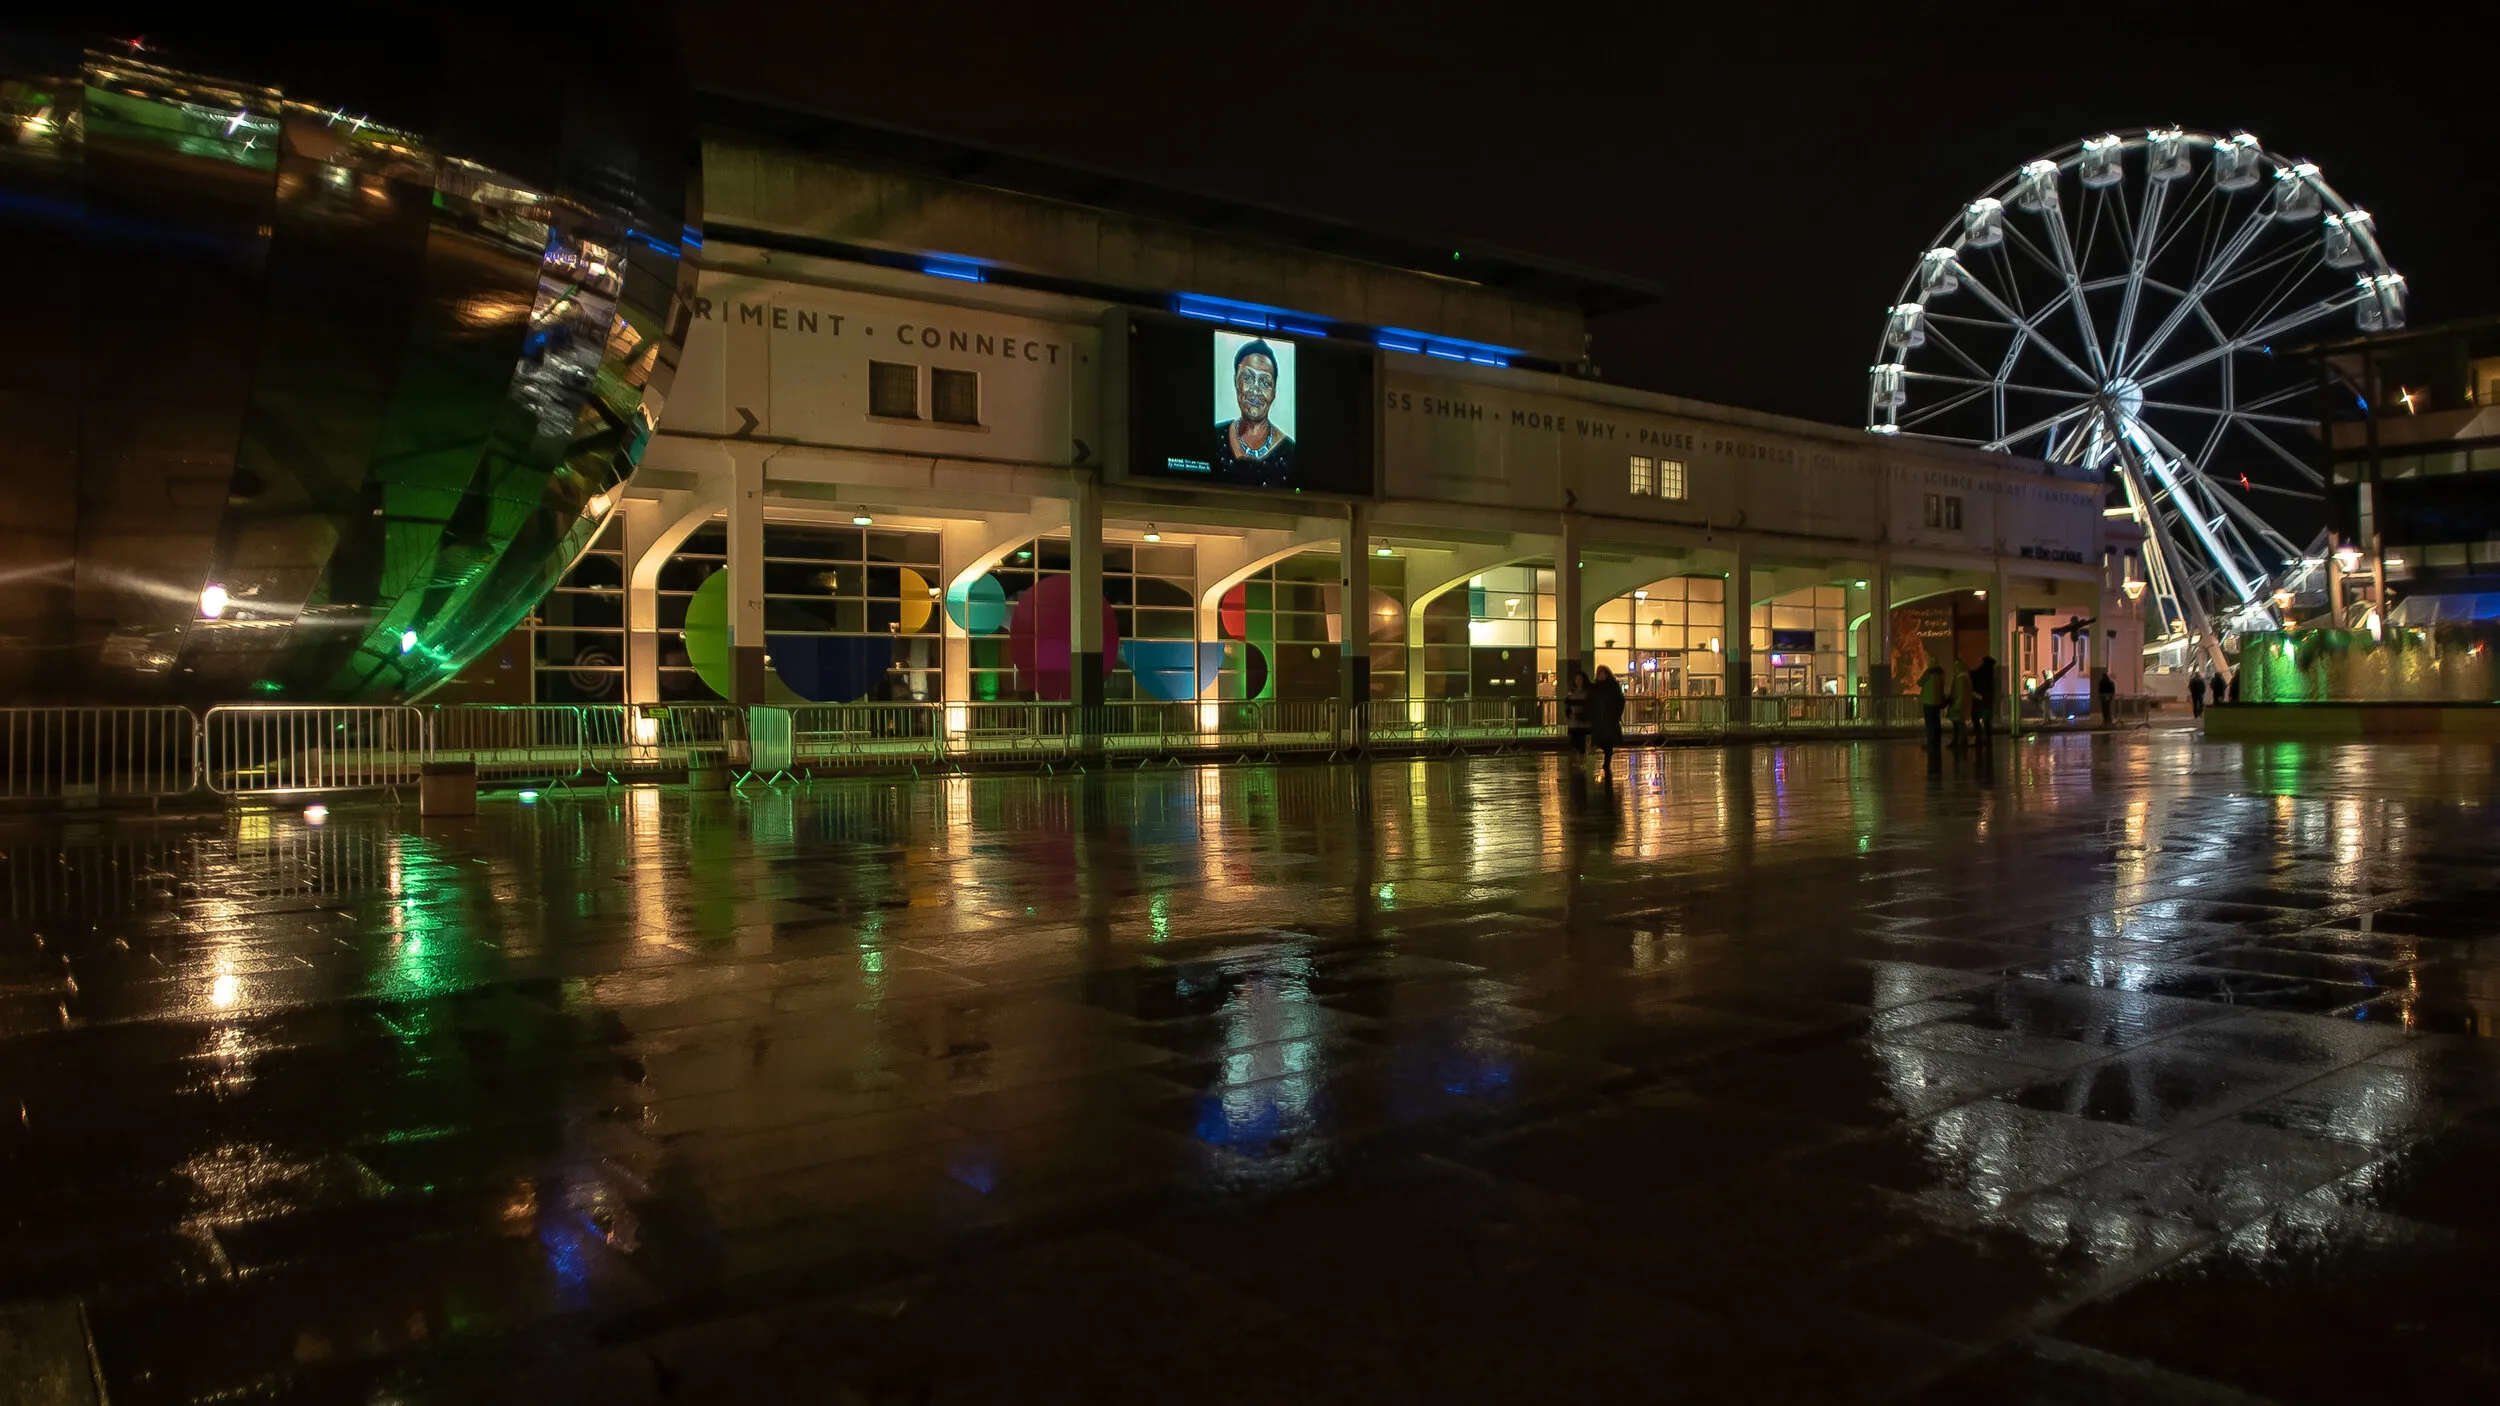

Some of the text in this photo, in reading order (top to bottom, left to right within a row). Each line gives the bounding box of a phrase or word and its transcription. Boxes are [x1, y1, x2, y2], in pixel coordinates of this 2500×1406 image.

[695, 297, 1061, 364] RIMENT CONNECT
[1423, 397, 1483, 421] SHHH
[1511, 409, 1566, 432] MORE
[1576, 419, 1616, 440] WHY
[1639, 428, 1694, 451] PAUSE
[1715, 440, 1794, 464] PROGRESS
[1924, 471, 1973, 490] SCIENCE
[1978, 480, 2003, 496] AND
